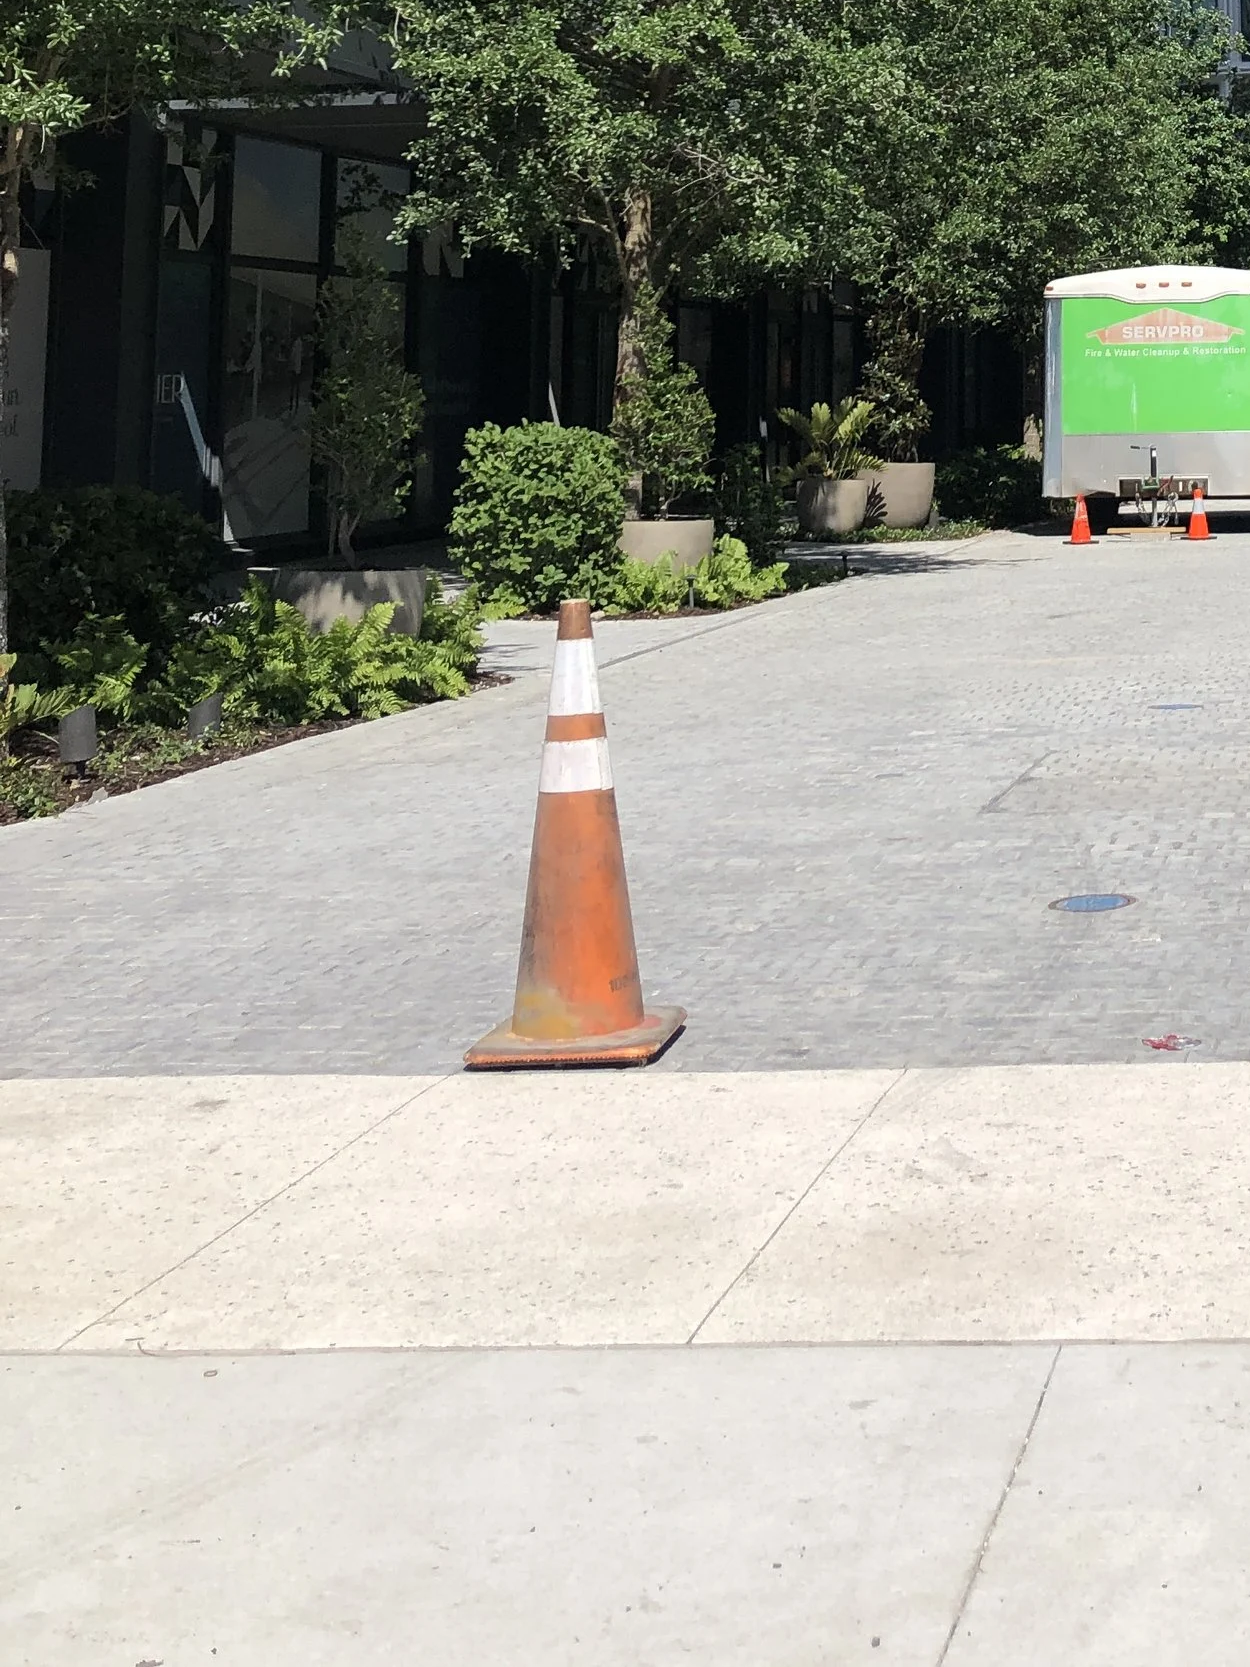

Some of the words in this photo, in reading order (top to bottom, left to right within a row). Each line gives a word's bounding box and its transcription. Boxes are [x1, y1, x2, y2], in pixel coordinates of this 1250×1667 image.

[1122, 325, 1204, 339] SERVPRO
[1085, 349, 1102, 357] Fire
[1105, 349, 1111, 357] &
[1114, 348, 1140, 357] Water
[1142, 347, 1180, 357] Cleanup
[1183, 347, 1189, 355] &
[1192, 346, 1246, 355] Restoration
